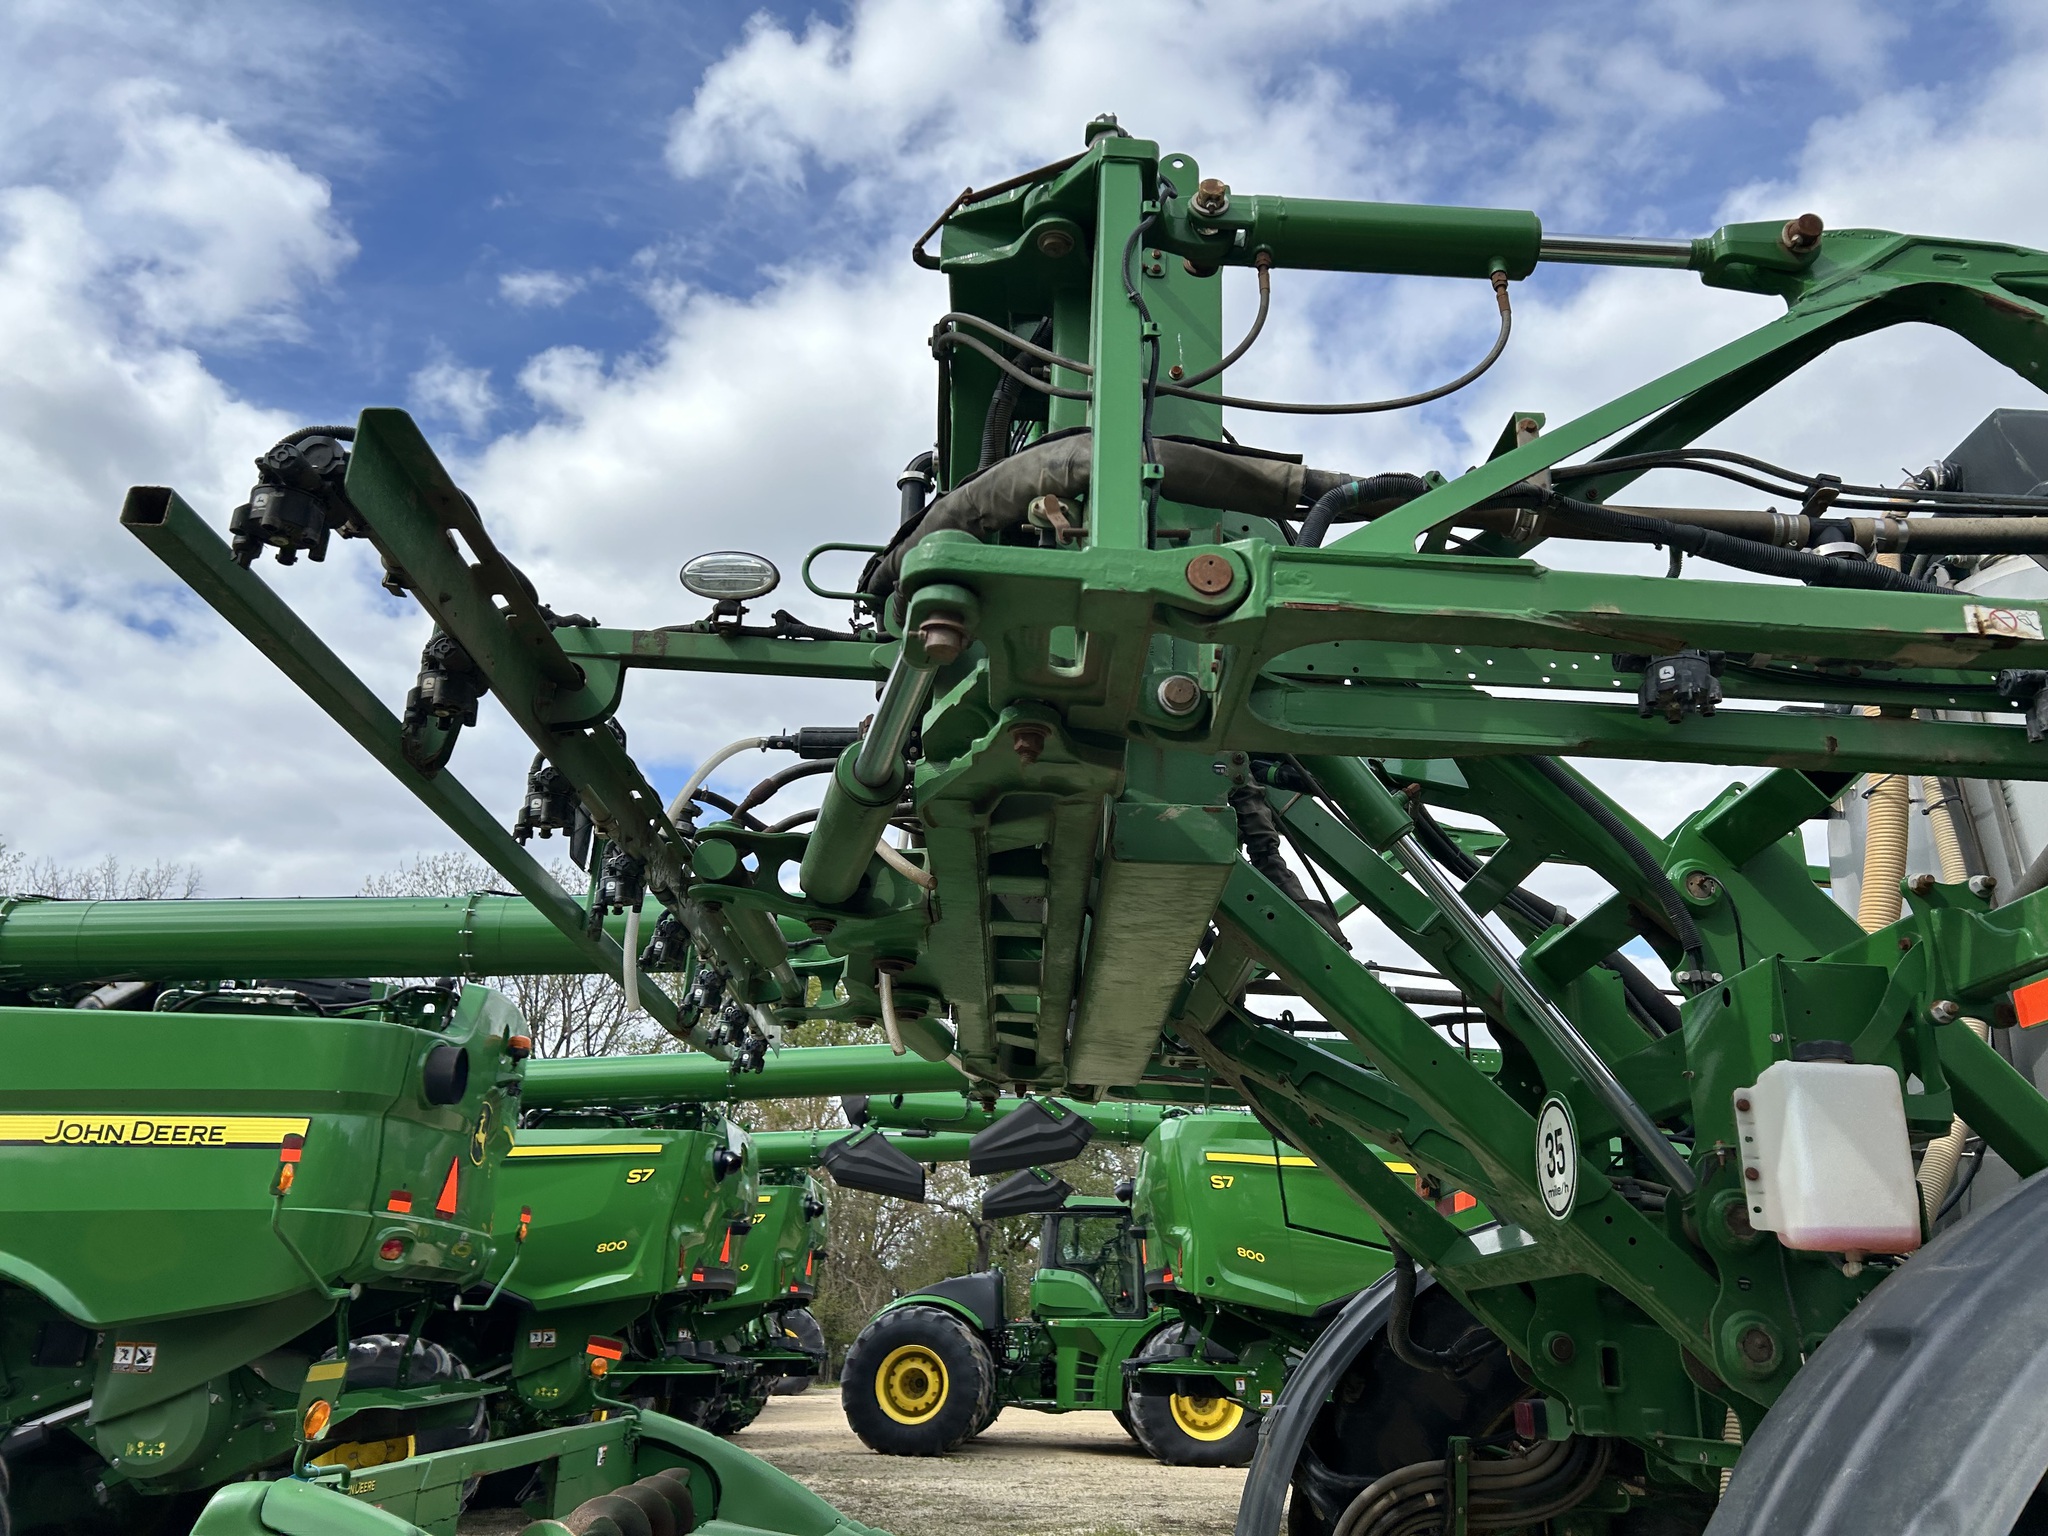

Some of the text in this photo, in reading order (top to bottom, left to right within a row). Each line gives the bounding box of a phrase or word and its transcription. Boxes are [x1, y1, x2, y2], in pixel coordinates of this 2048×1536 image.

[45, 1120, 227, 1142] JOHN DEERE
[1545, 1127, 1566, 1178] 35
[626, 1168, 656, 1184] S7
[1210, 1174, 1235, 1190] S7
[1547, 1181, 1570, 1199] mile/h
[596, 1240, 628, 1253] 800
[1236, 1246, 1266, 1263] 800
